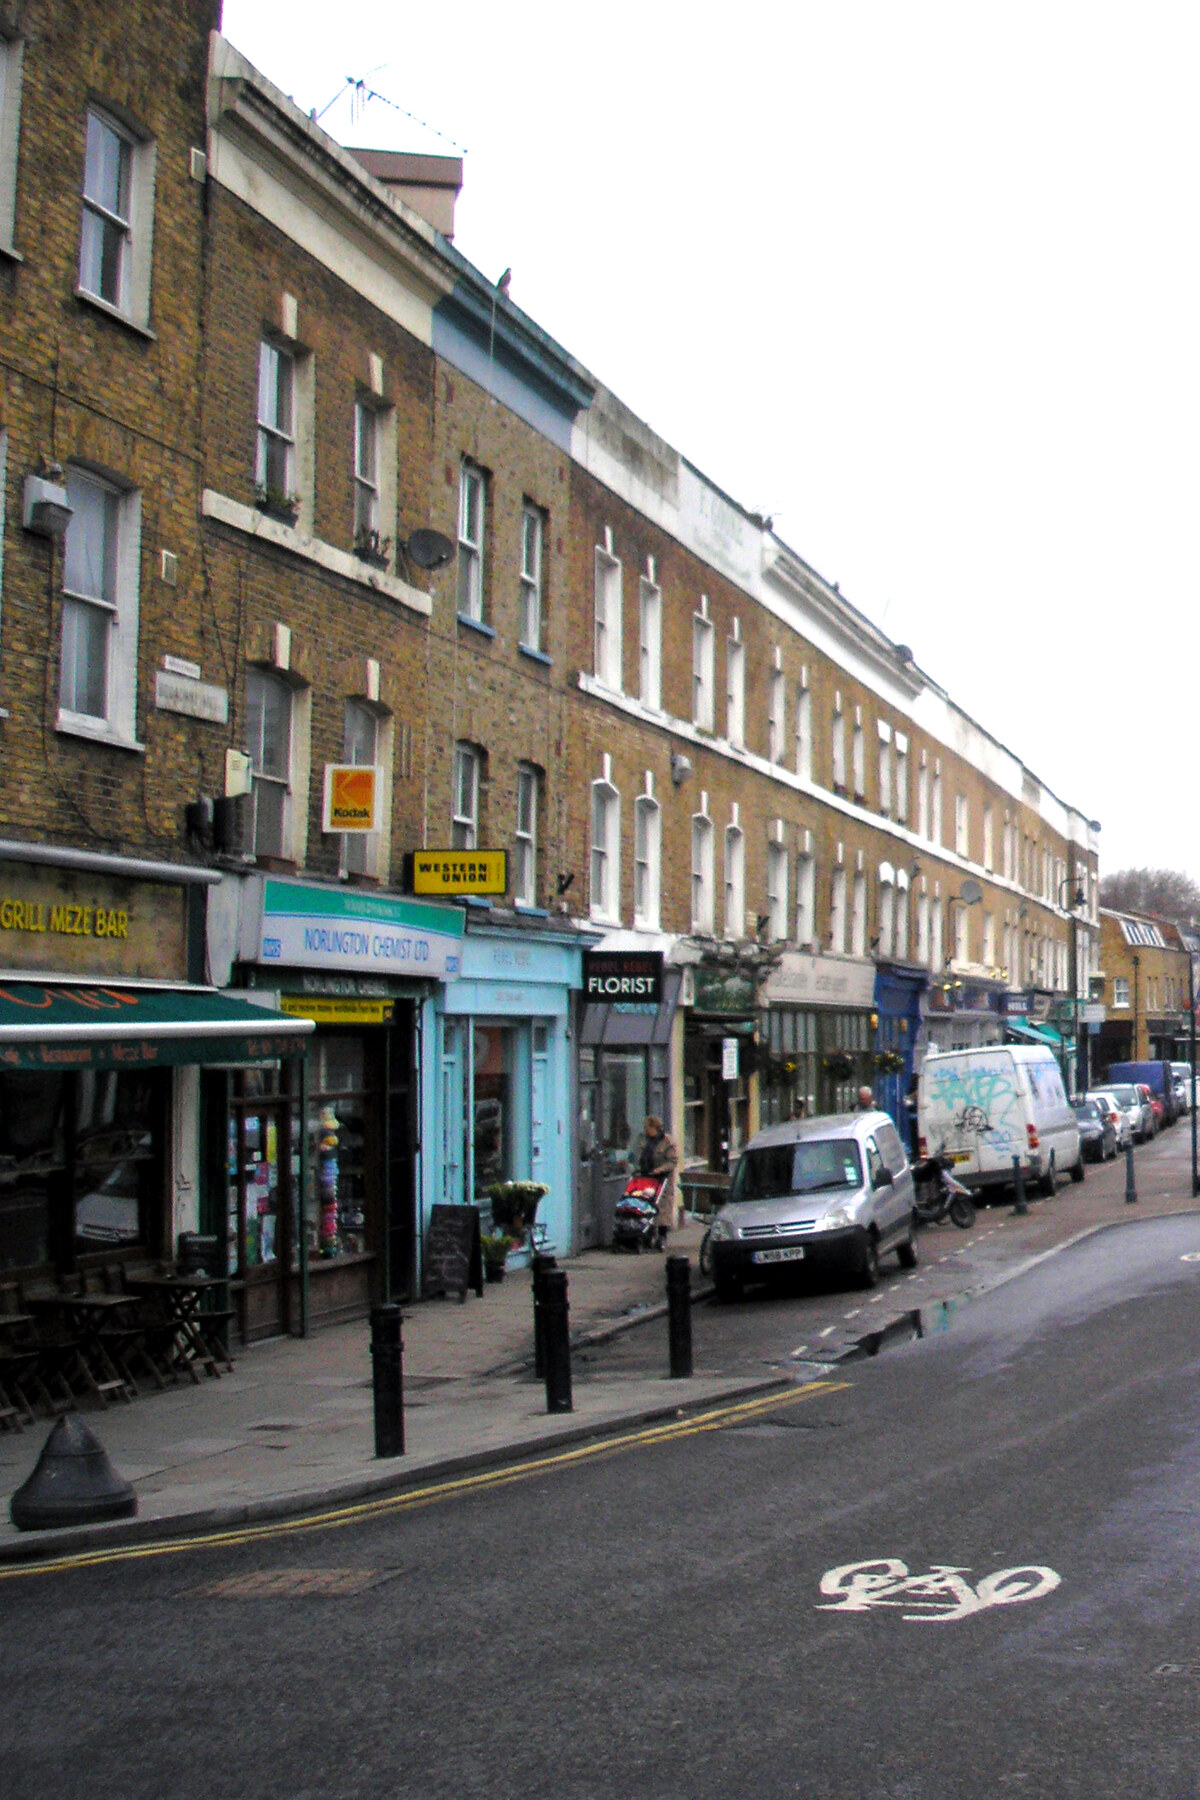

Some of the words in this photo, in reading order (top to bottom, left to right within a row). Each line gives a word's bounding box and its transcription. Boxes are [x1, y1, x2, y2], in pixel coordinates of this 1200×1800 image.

[334, 808, 370, 818] Kodak
[419, 863, 487, 873] WESTERN
[442, 873, 487, 883] UNION
[1, 900, 46, 933] GRILL
[51, 904, 92, 936] MEZE
[95, 907, 129, 939] BAR
[304, 927, 369, 955] NORLINGTON
[374, 936, 412, 959] CHEMIST
[415, 940, 430, 961] LTD
[588, 977, 655, 993] FLORIST
